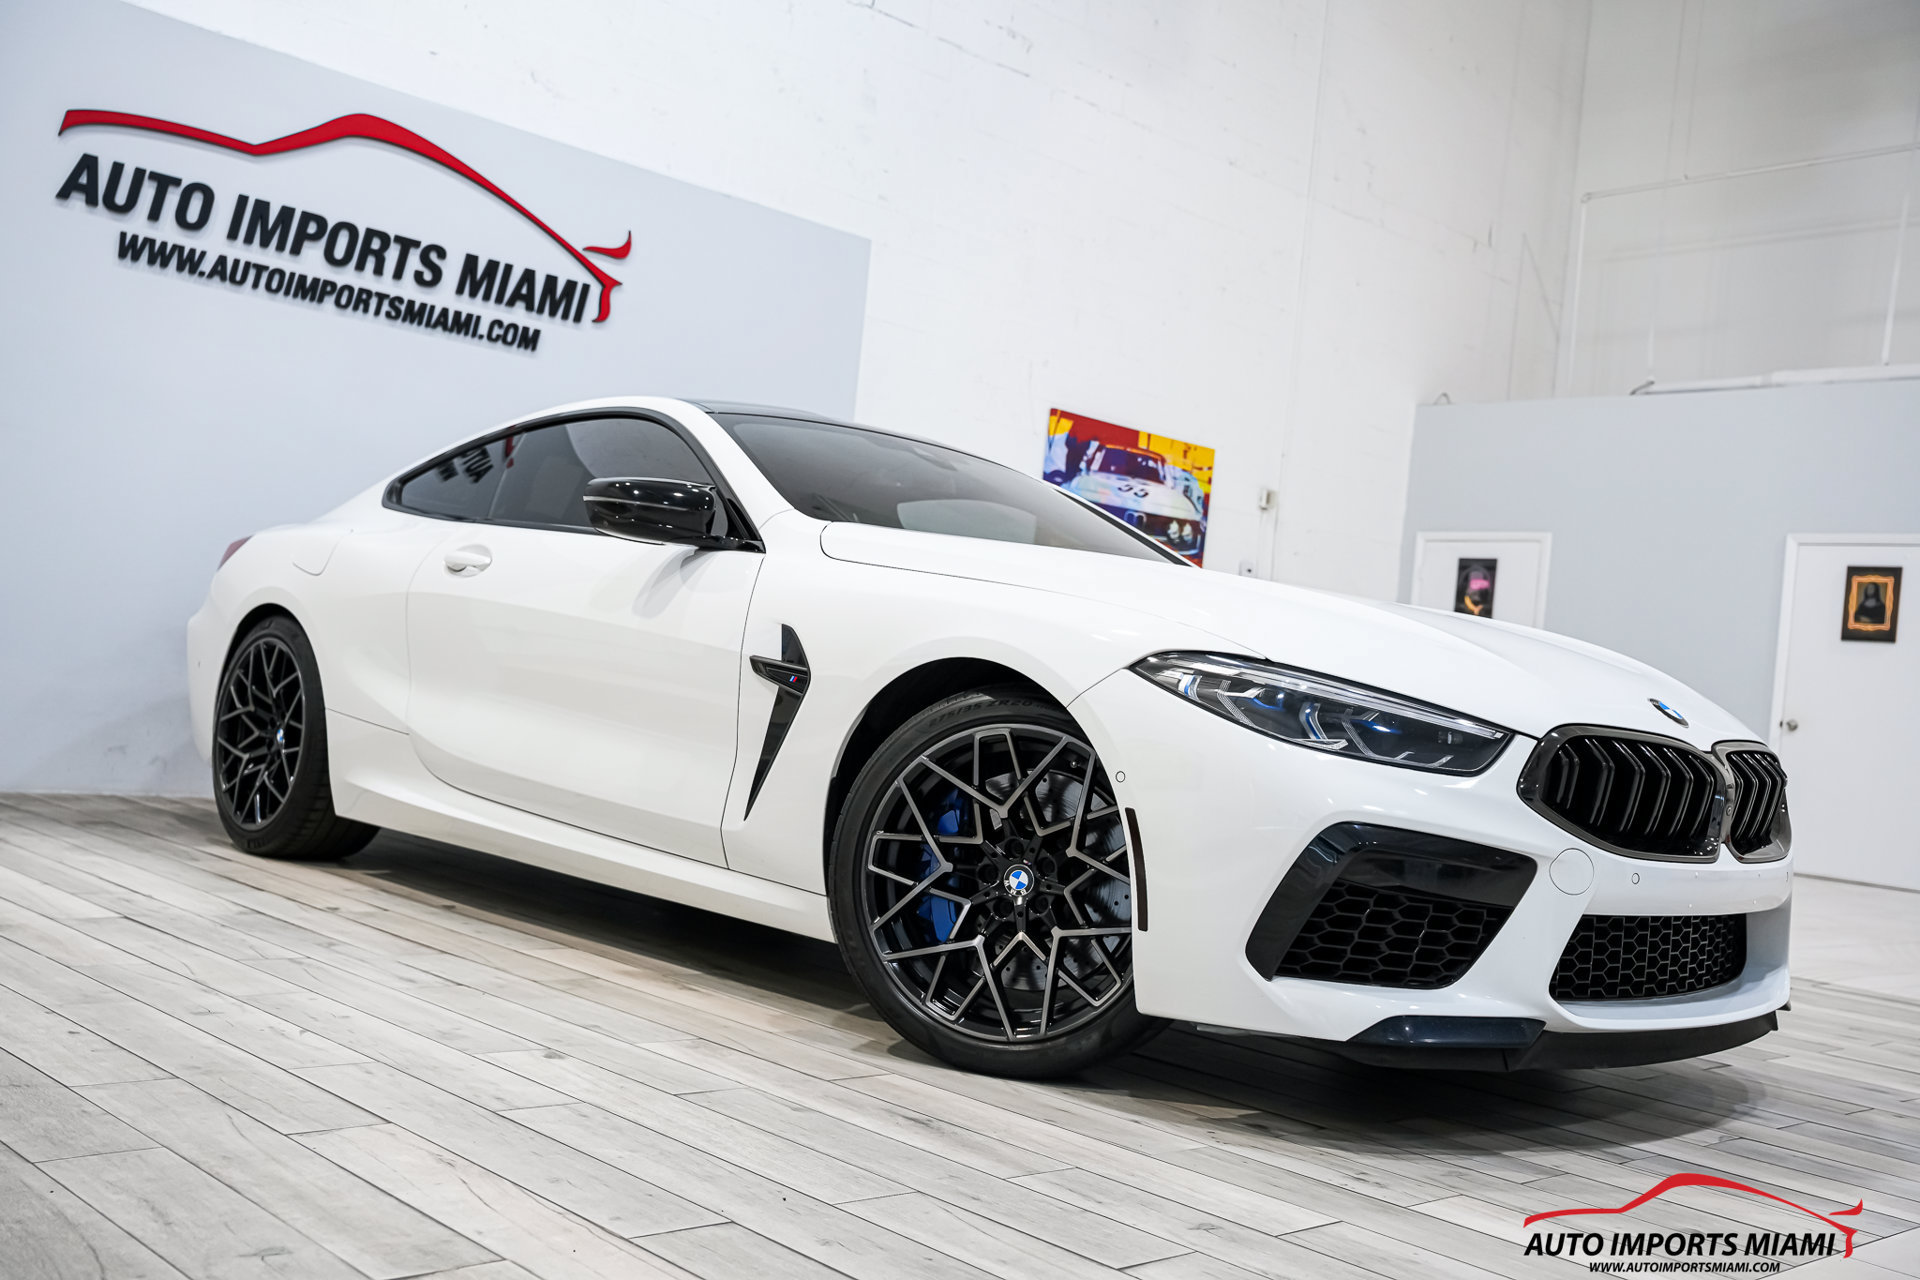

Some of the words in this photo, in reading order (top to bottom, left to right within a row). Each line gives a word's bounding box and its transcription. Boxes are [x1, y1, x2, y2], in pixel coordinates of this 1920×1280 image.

[55, 153, 215, 231] AUTO
[226, 194, 447, 288] IMPORTS
[455, 253, 591, 323] MIAMI
[117, 231, 541, 352] WWW.AUTOIMPORTSMIAMI.COM
[986, 699, 1033, 708] ZR20
